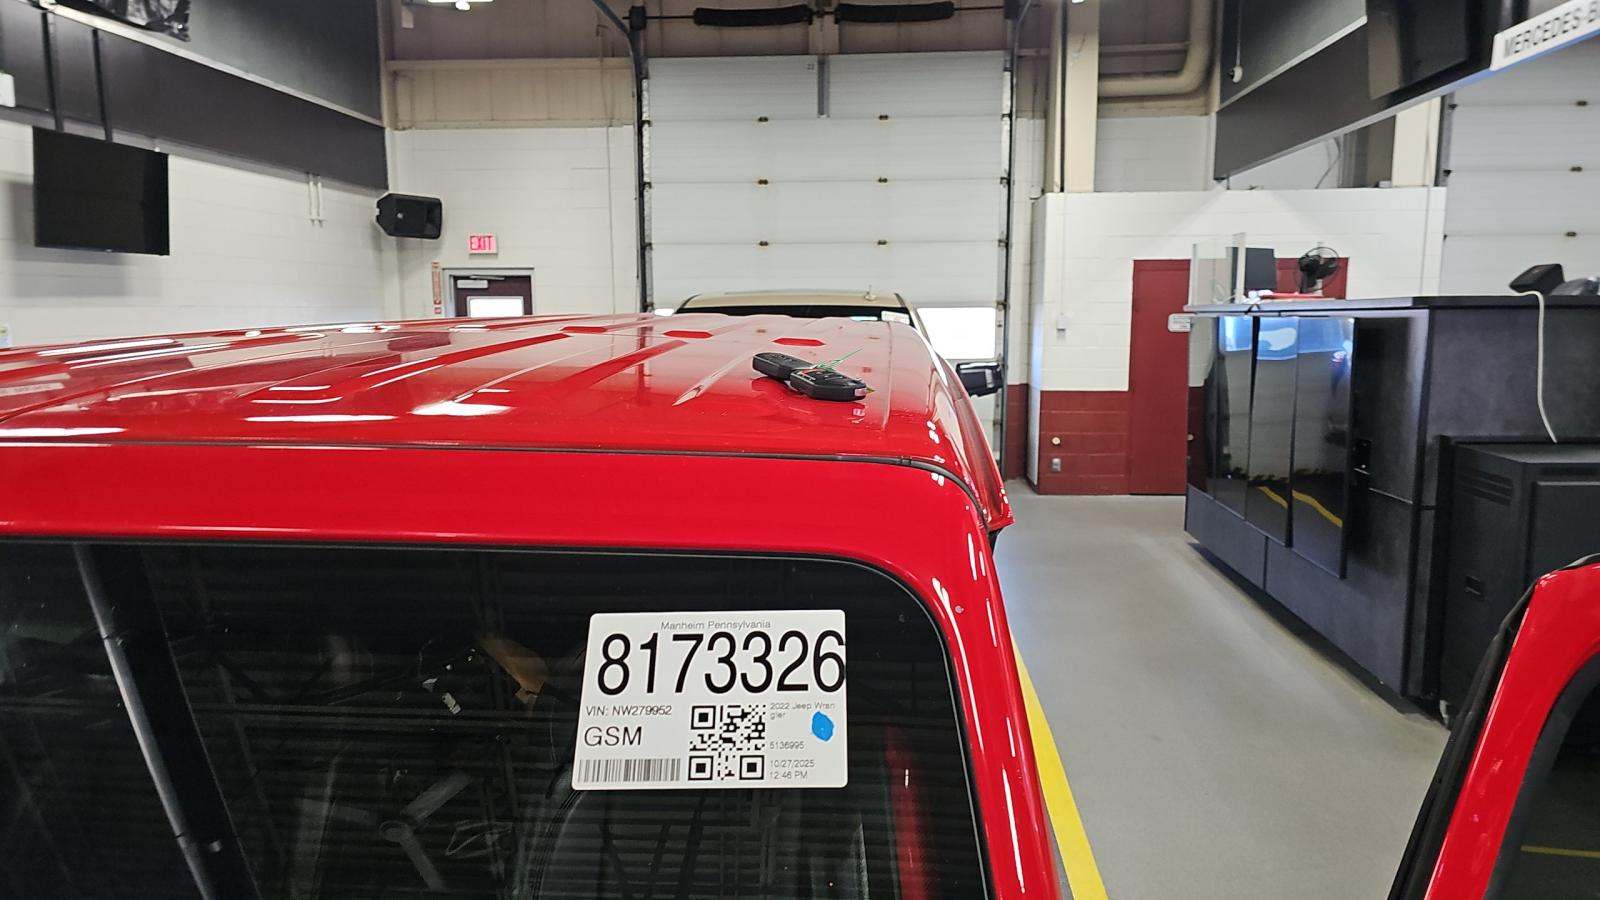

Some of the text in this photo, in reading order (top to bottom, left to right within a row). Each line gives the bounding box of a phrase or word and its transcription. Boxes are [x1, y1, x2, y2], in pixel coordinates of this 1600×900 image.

[469, 235, 493, 251] EXIT
[660, 620, 771, 630] Manheim Pennsylvania
[597, 630, 846, 696] 8173326
[586, 705, 609, 716] VIN:
[770, 702, 790, 710] 2022
[584, 726, 642, 747] GSM
[794, 770, 808, 779] PM
